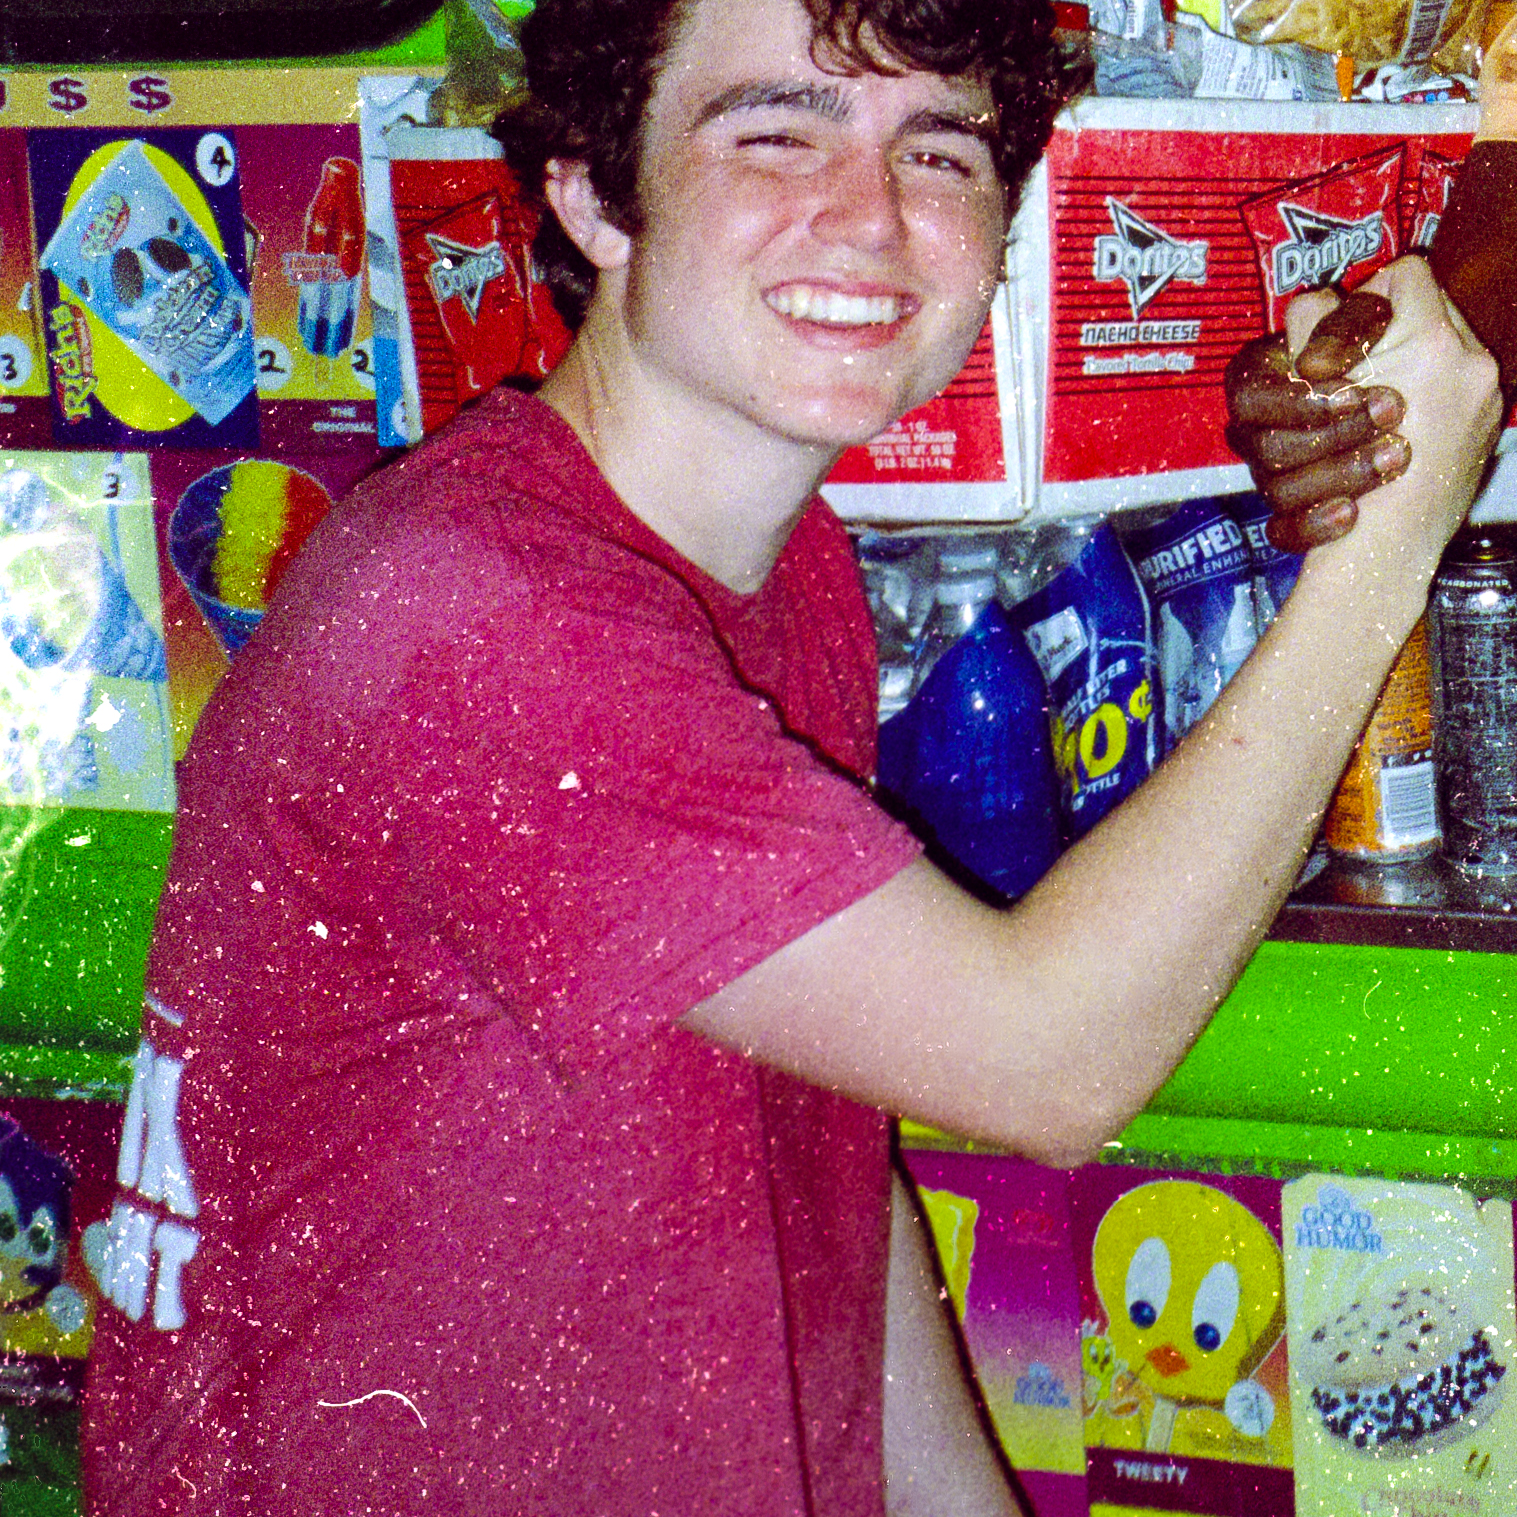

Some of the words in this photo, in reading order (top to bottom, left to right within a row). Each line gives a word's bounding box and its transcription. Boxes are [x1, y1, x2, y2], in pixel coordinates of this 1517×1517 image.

[48, 75, 88, 114] $
[129, 75, 172, 114] $
[209, 145, 230, 172] 4
[1096, 237, 1208, 284] Doritos
[1275, 212, 1385, 295] Doritos
[1141, 318, 1200, 339] CHEESE
[2, 353, 18, 380] 3
[258, 349, 287, 375] 2
[351, 349, 374, 375] 2
[104, 472, 119, 499] 3
[1302, 1206, 1373, 1231] GOOD
[1296, 1225, 1384, 1254] HUMOR
[1113, 1458, 1189, 1485] TWEETY
